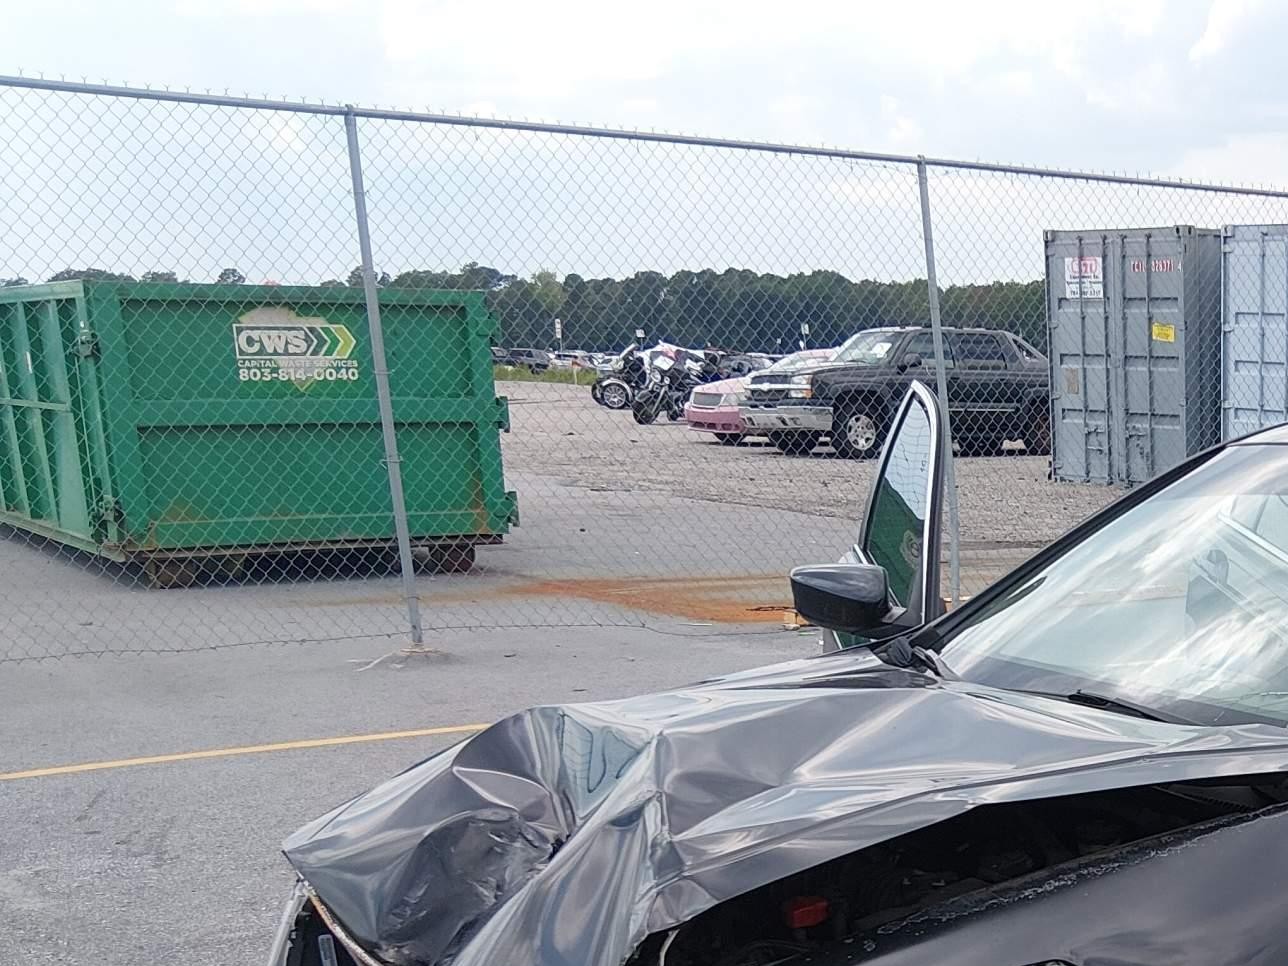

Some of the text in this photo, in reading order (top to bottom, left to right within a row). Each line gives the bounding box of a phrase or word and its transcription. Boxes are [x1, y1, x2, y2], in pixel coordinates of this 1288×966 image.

[238, 330, 307, 353] CWS
[237, 360, 277, 368] CAPITAL
[313, 360, 358, 368] SERVICES
[239, 369, 359, 381] 803-814-0040
